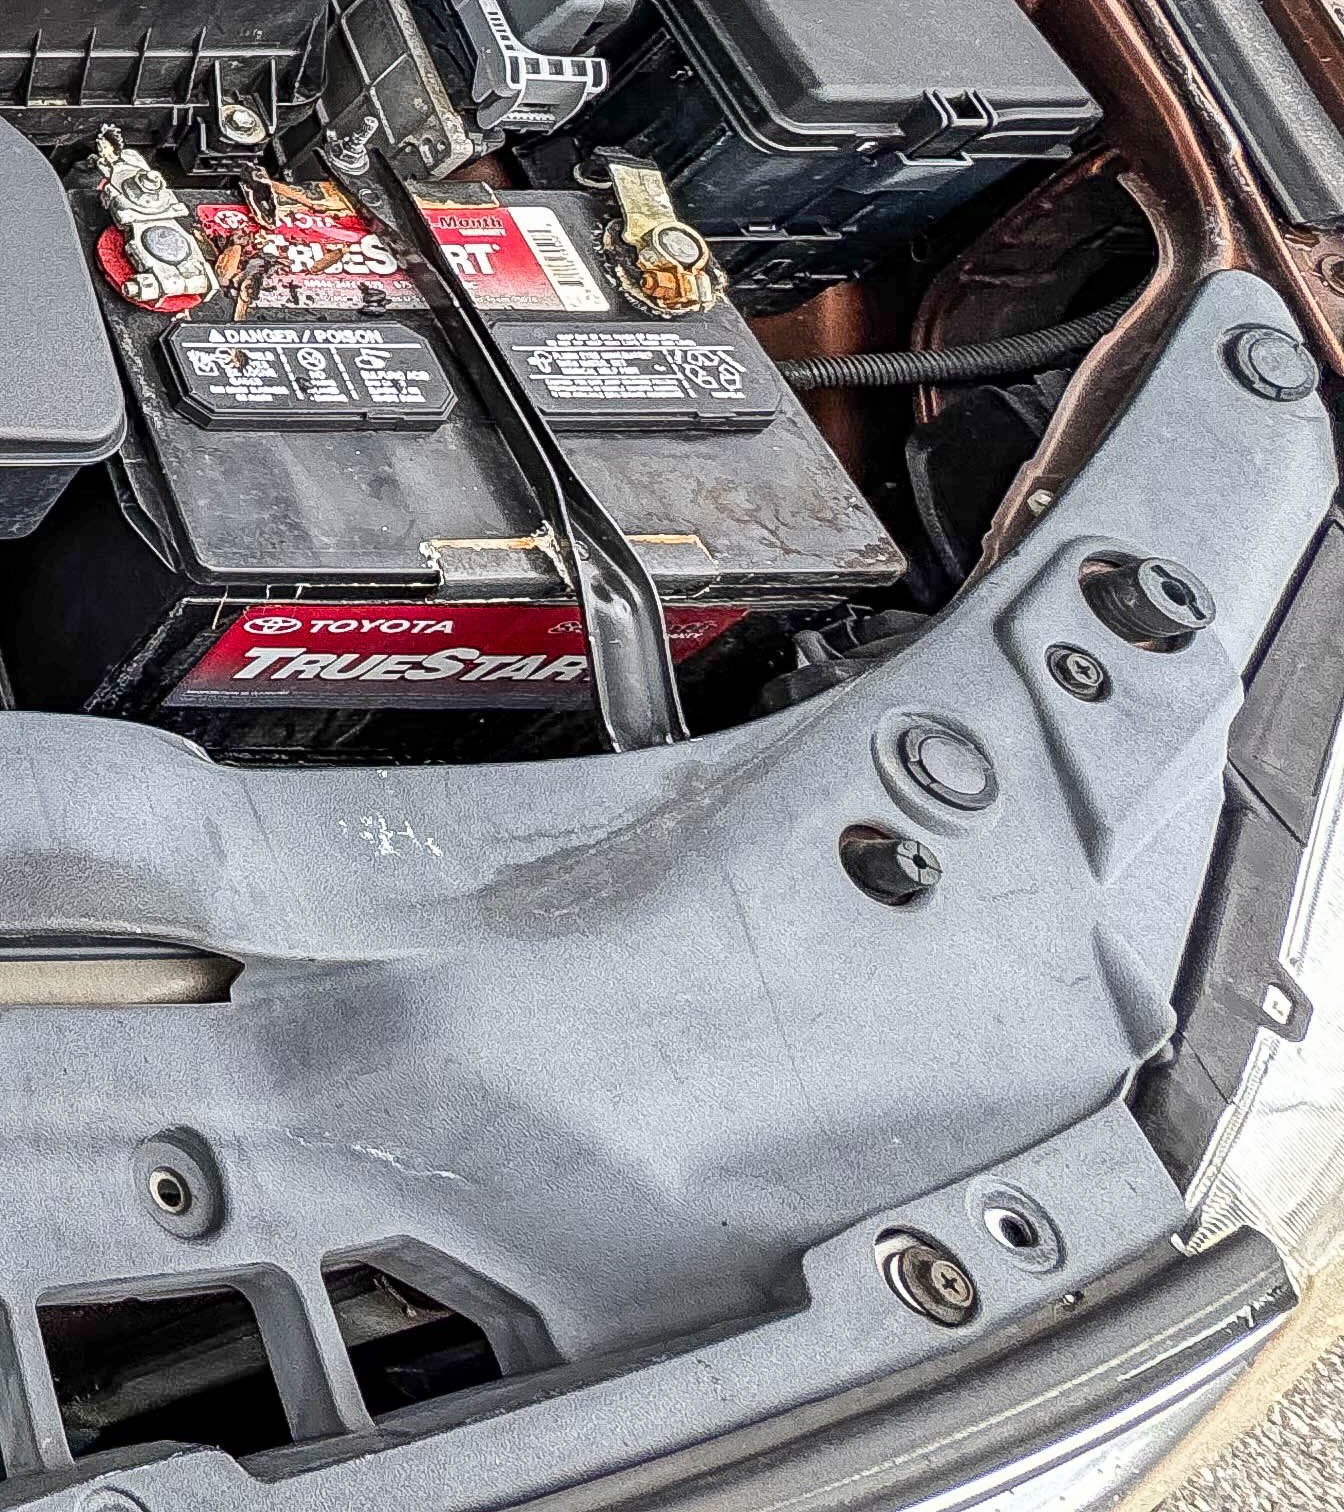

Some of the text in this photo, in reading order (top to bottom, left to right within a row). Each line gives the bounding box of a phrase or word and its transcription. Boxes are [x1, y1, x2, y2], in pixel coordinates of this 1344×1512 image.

[225, 329, 299, 343] DANGER
[313, 329, 383, 343] POISON
[309, 619, 454, 635] TOYOTA
[231, 647, 593, 683] TRUESTAR
